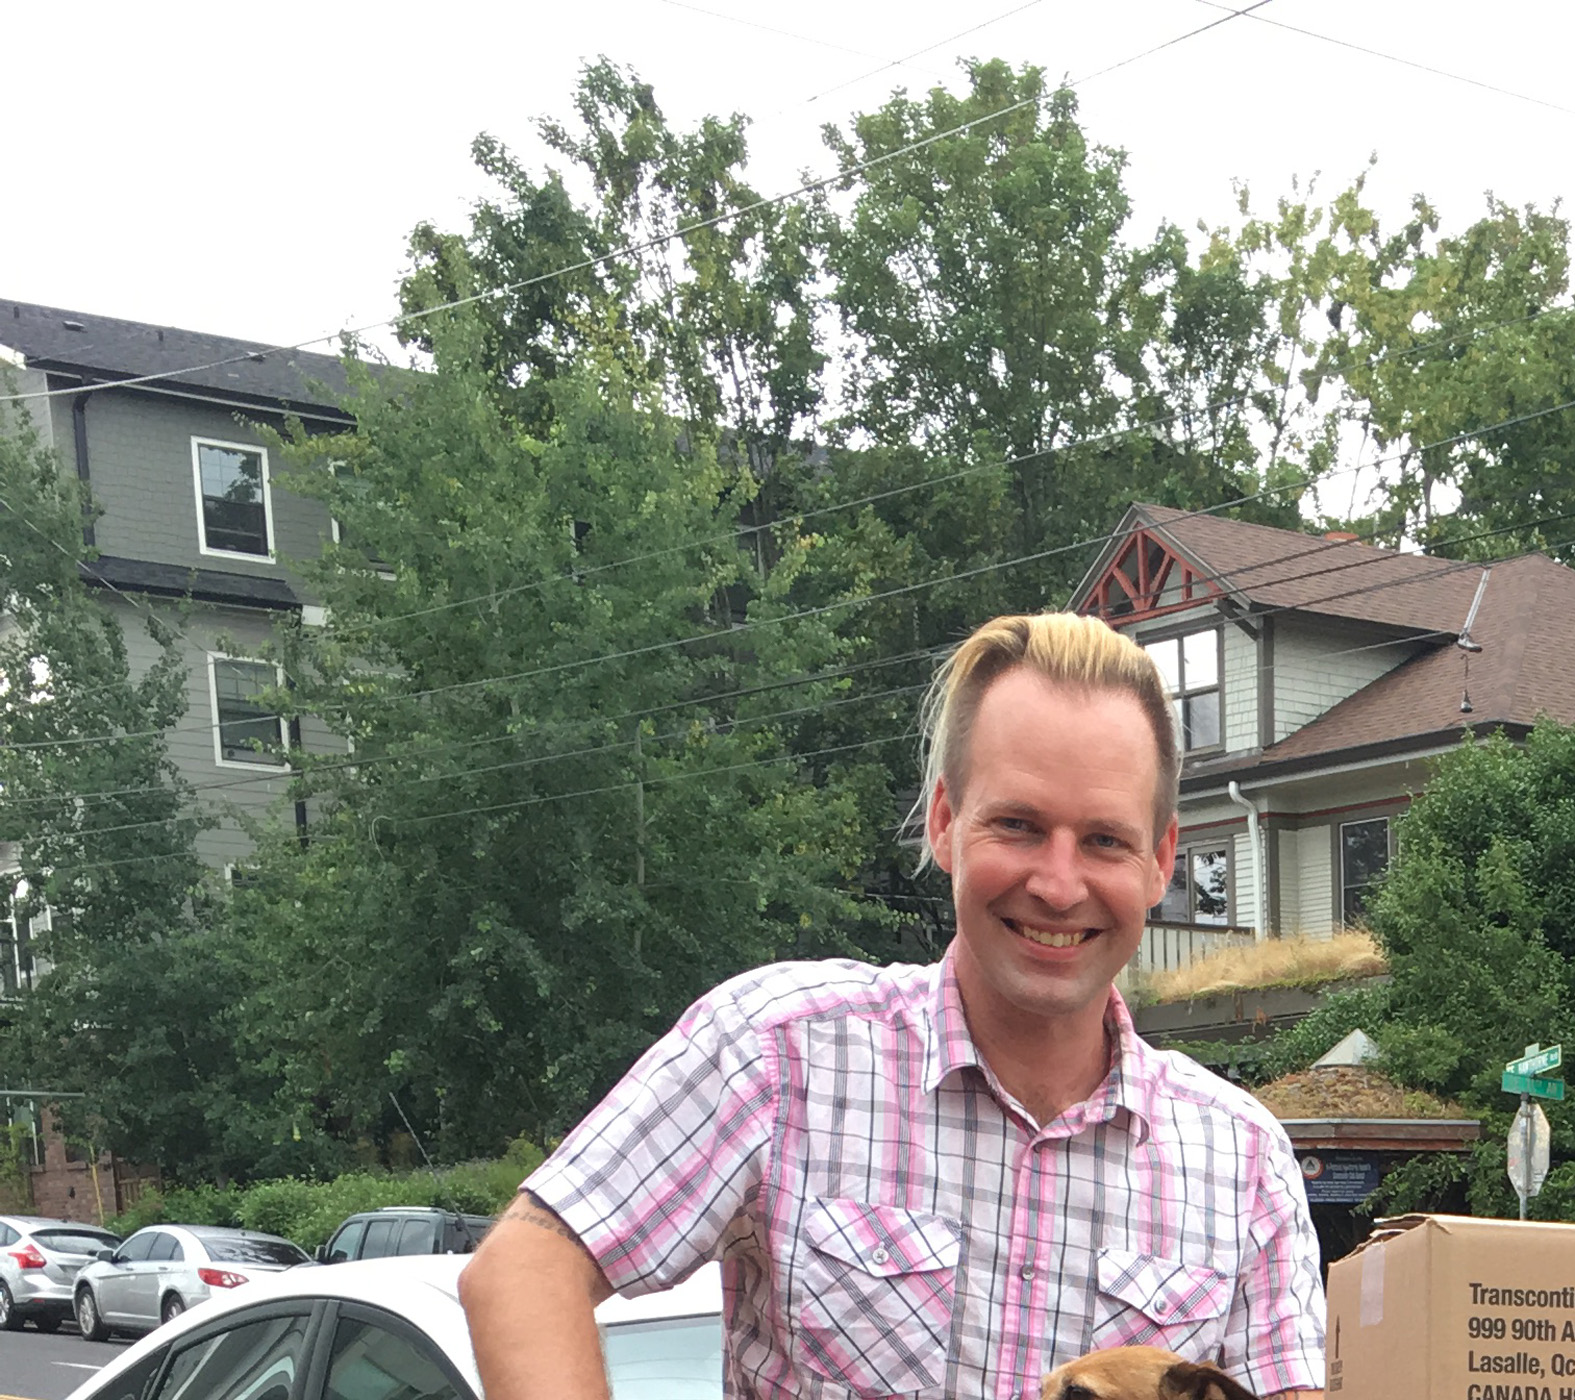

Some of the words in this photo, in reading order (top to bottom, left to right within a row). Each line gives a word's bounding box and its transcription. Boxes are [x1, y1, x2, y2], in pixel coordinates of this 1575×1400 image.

[1468, 1317, 1507, 1340] 999
[1511, 1319, 1557, 1342] 90th
[1468, 1350, 1546, 1379] Lasalle,
